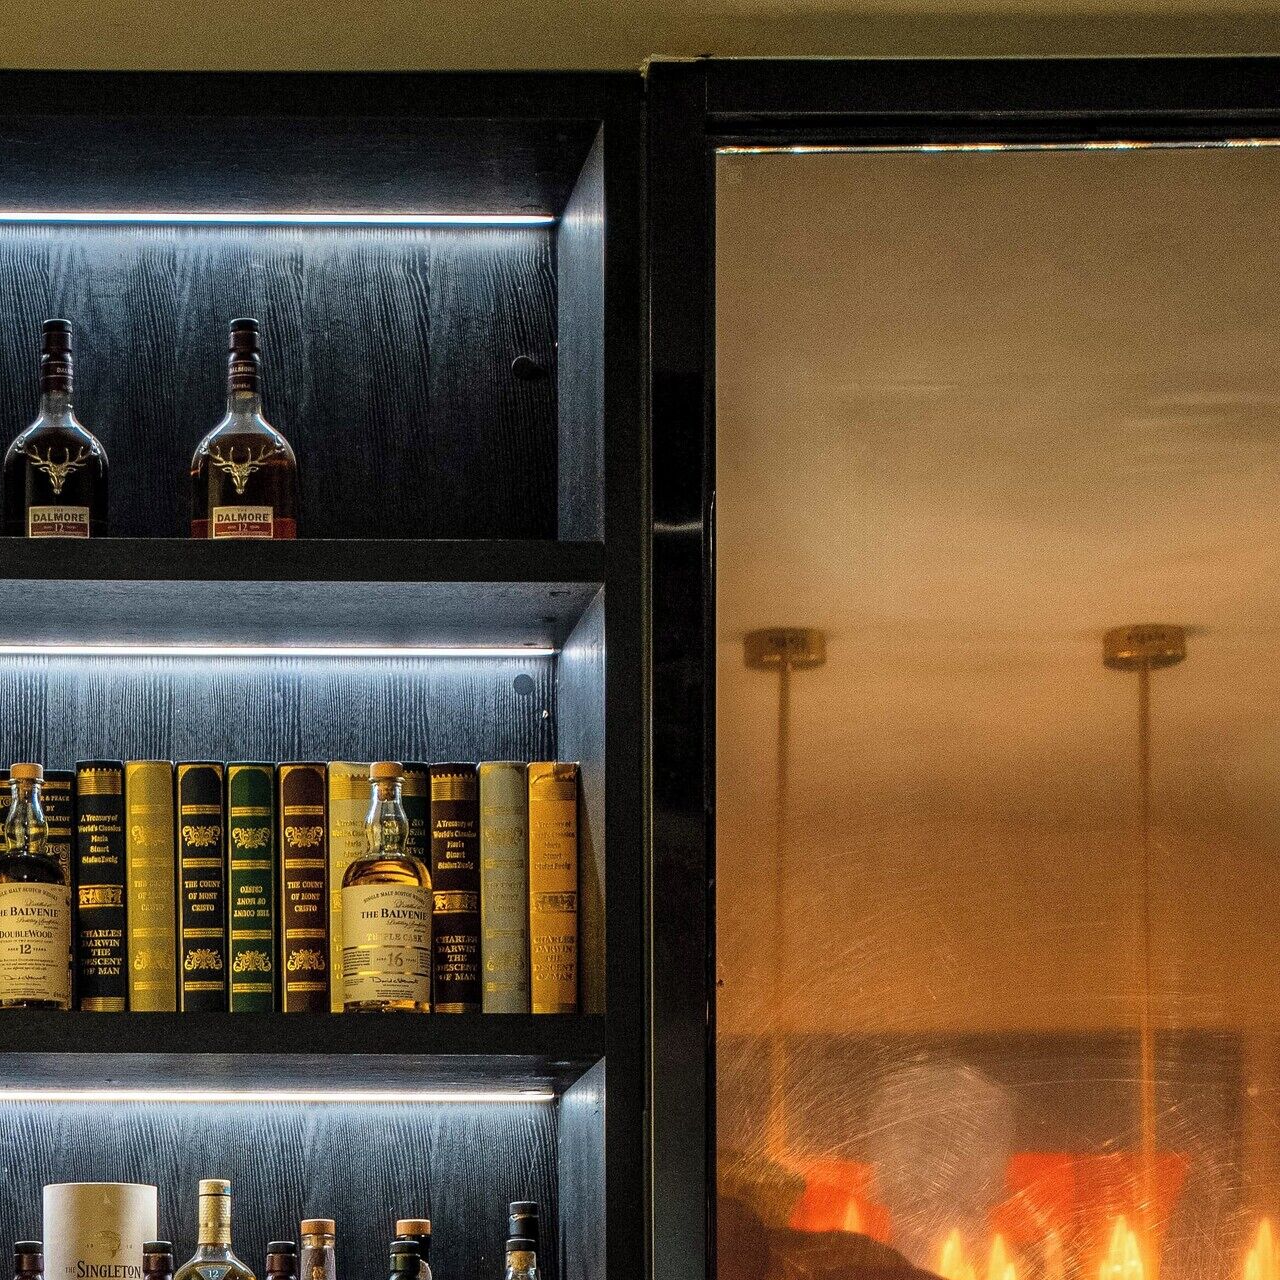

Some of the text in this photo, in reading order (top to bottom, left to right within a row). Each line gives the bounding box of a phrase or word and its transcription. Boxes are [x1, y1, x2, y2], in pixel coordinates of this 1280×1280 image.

[33, 513, 85, 522] DALMORE
[217, 513, 269, 522] DALMORE
[55, 523, 64, 531] 12
[238, 523, 247, 531] 12
[10, 906, 59, 917] BALVENIE
[361, 908, 427, 920] THE BALVENIE
[20, 945, 32, 954] 12
[387, 953, 403, 966] 16
[77, 1260, 140, 1279] SINGLETON
[209, 1270, 219, 1278] 12
